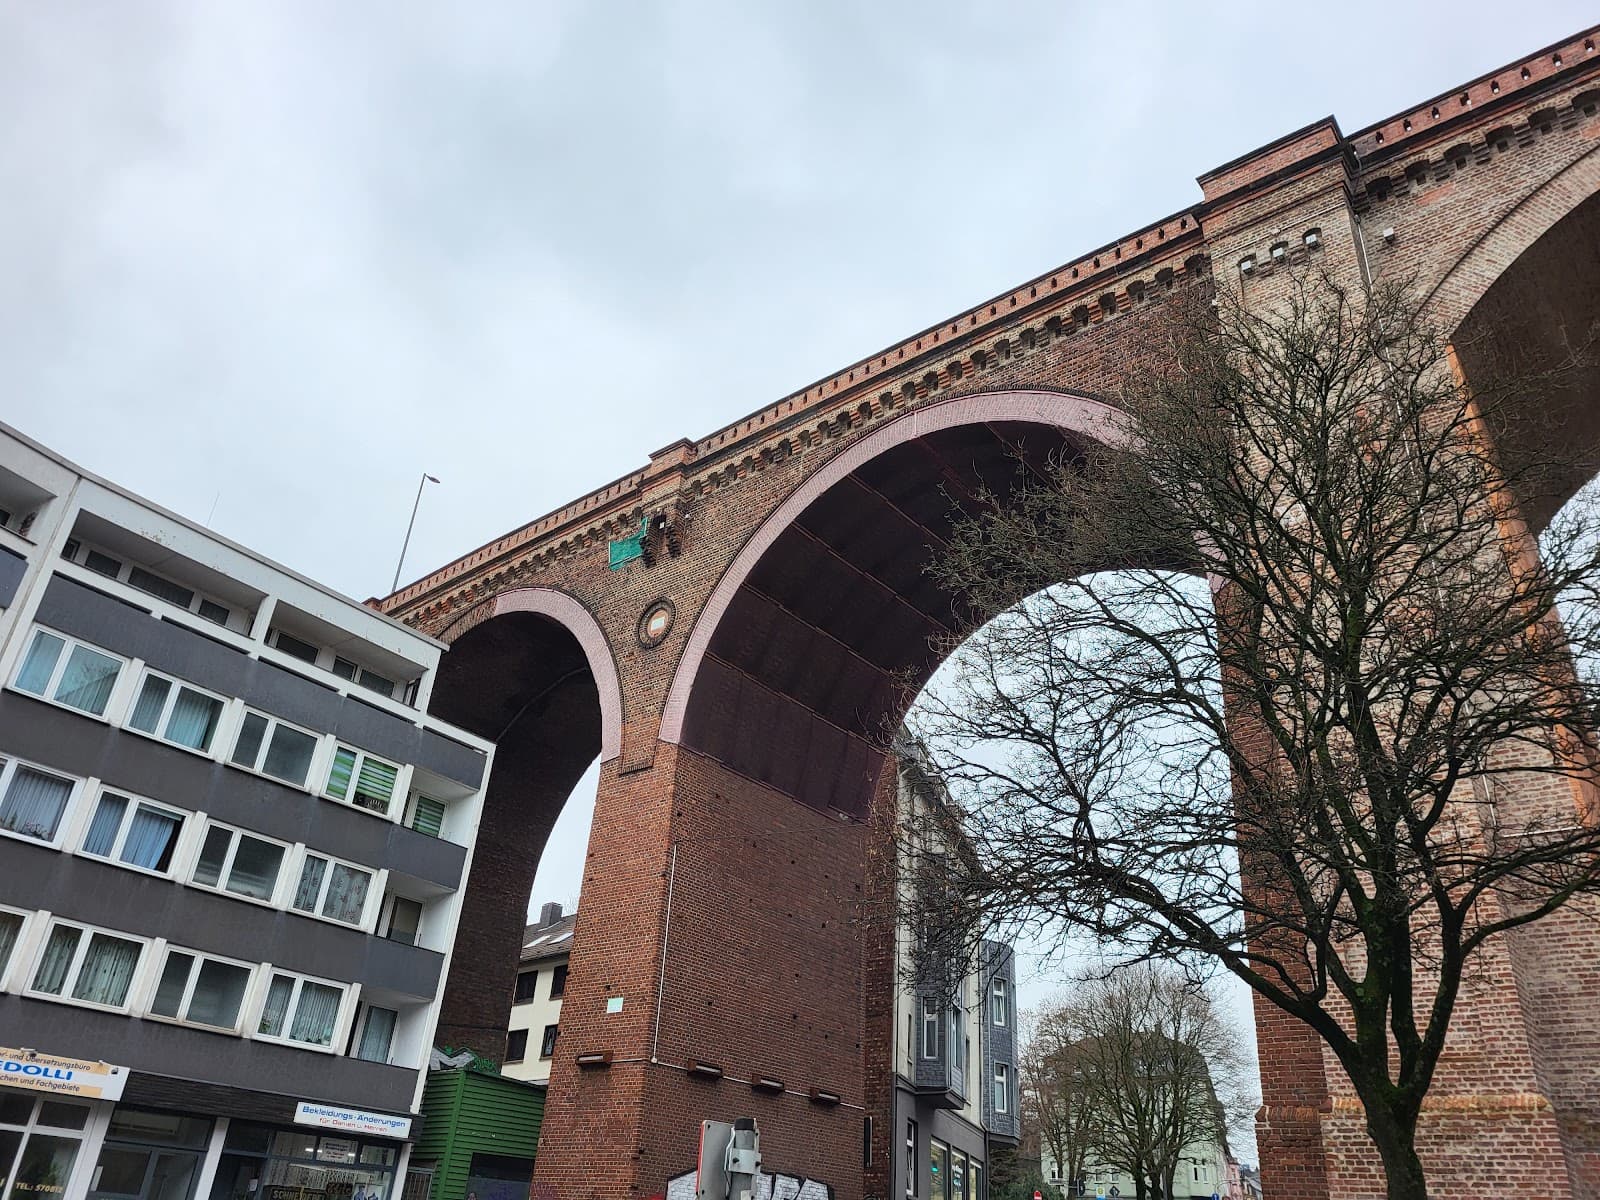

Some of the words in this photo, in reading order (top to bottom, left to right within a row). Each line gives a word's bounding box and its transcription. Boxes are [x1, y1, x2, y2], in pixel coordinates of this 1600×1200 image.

[0, 1061, 73, 1080] DOLLI
[36, 1079, 80, 1092] Fachgebiete
[332, 1119, 356, 1128] Damen
[364, 1124, 388, 1132] Herren
